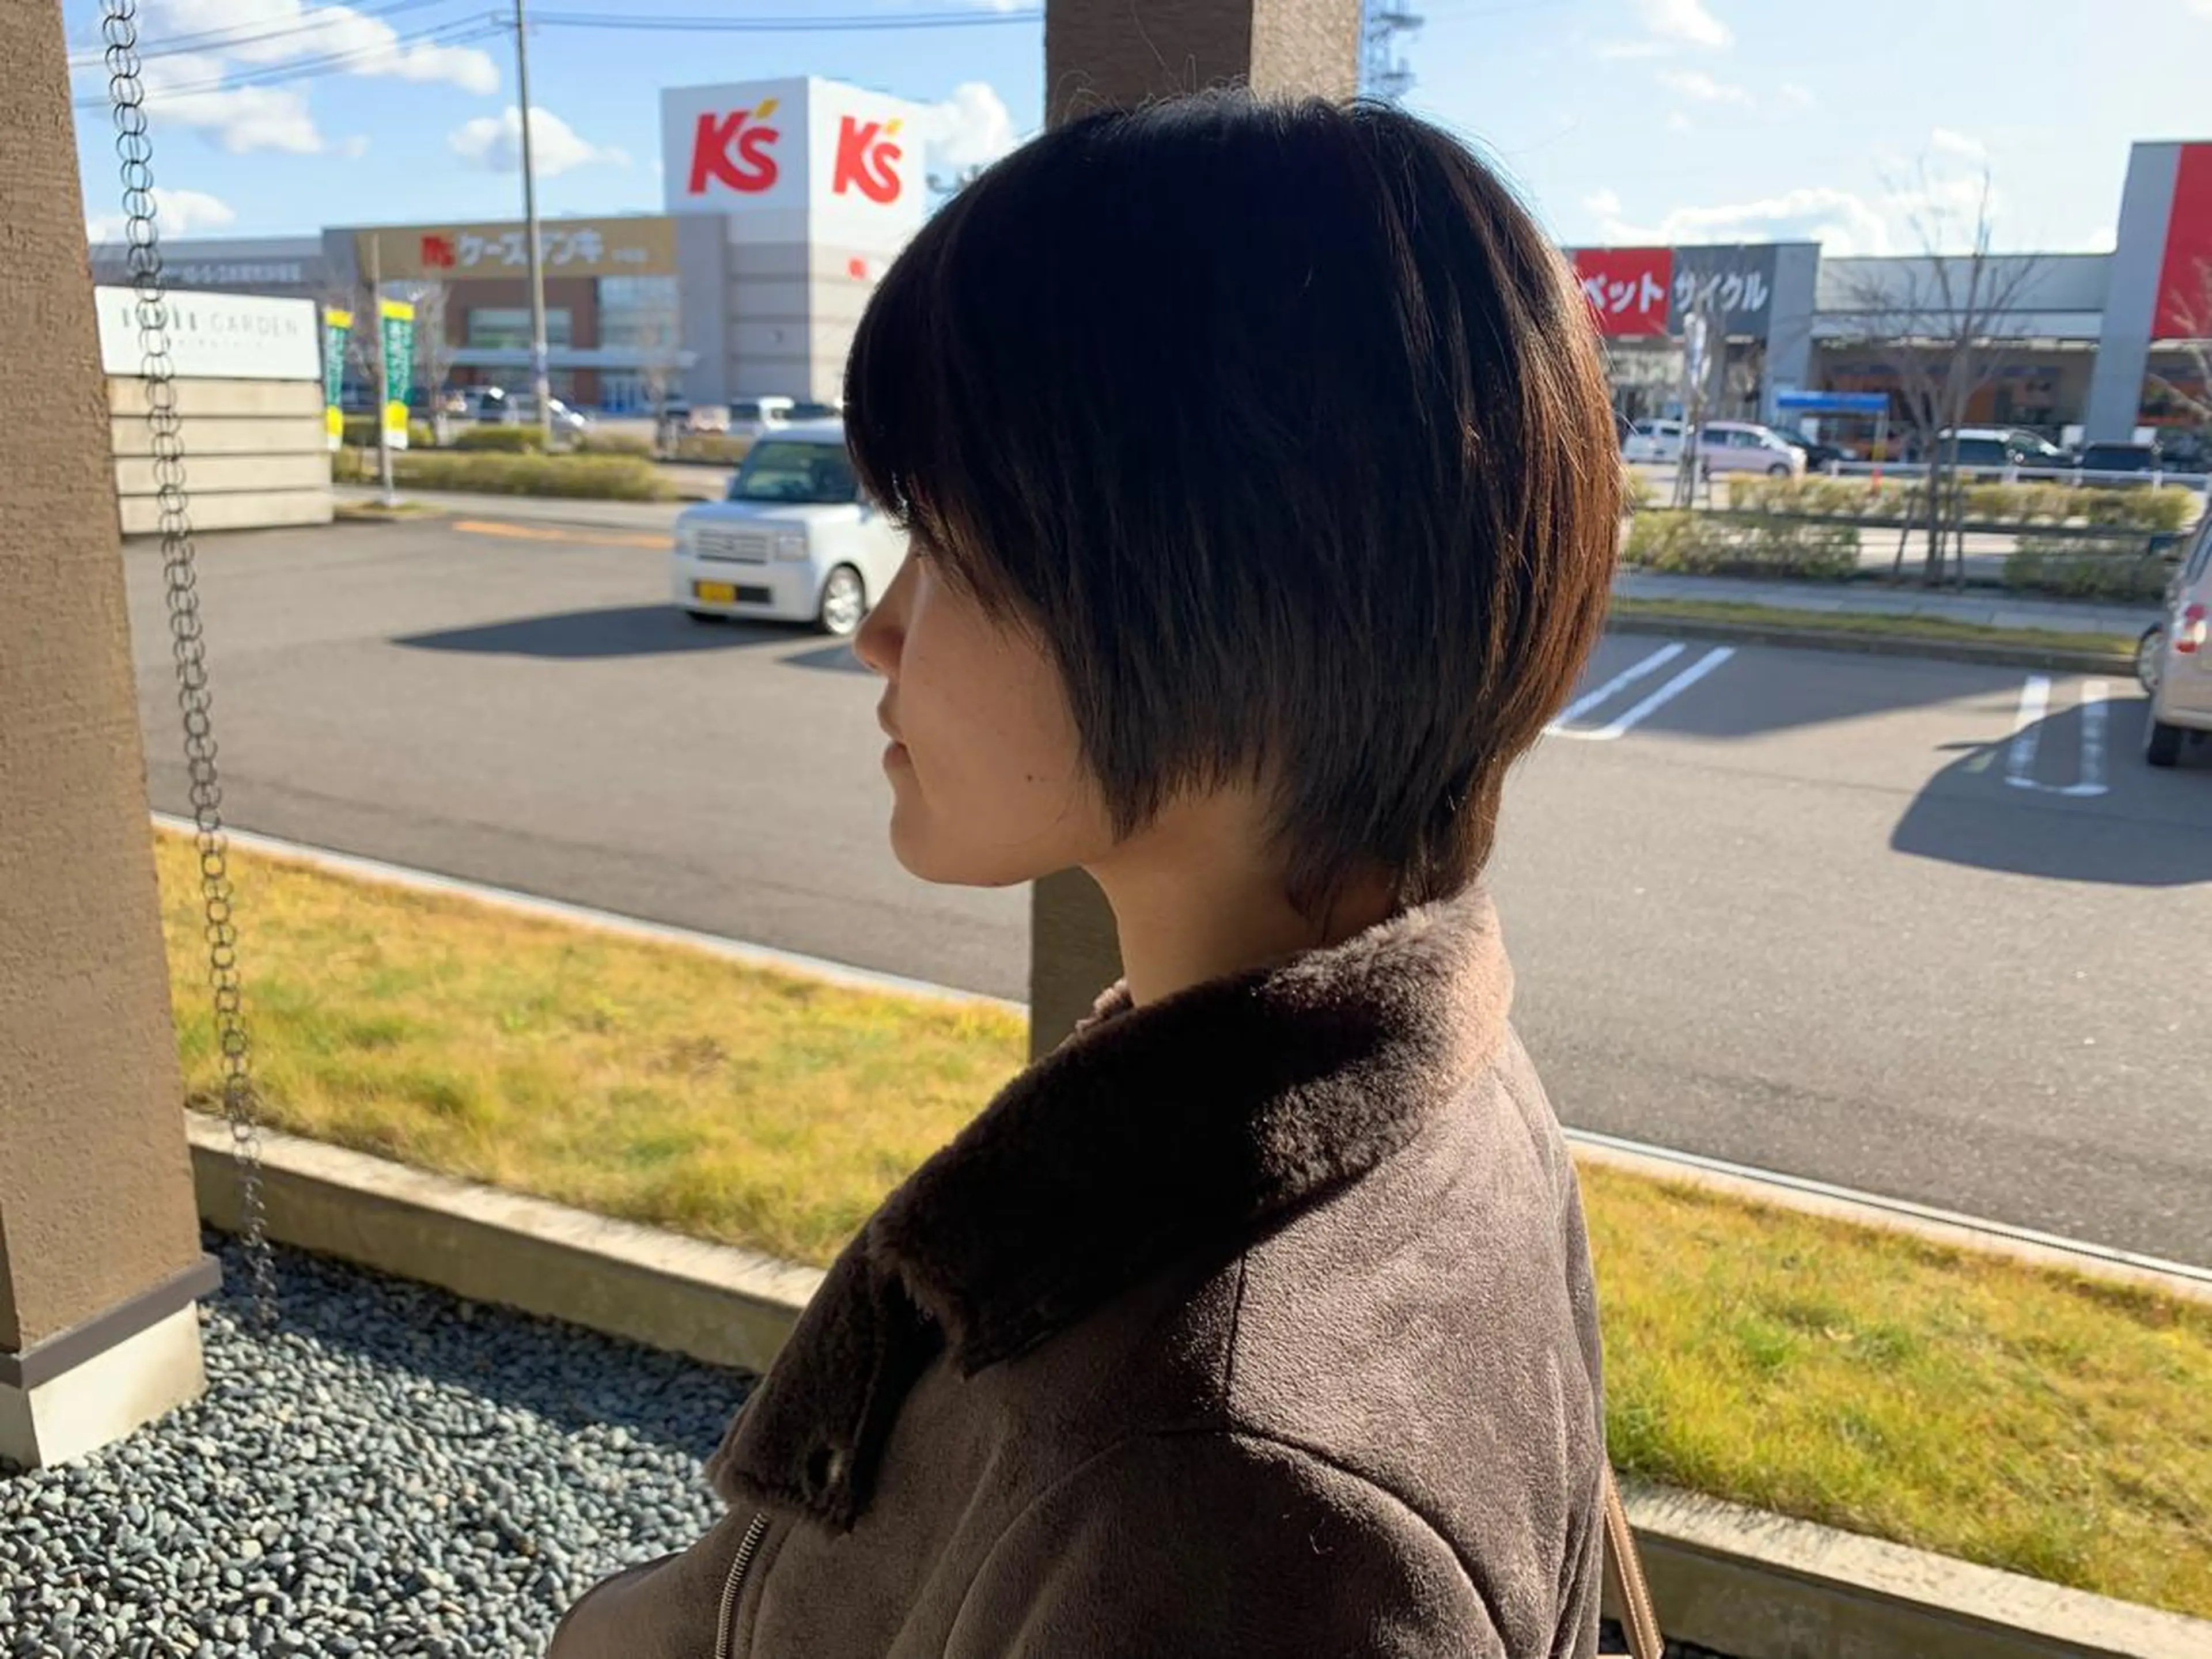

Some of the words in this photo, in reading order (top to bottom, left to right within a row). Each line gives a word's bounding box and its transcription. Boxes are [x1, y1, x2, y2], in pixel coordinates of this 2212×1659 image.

[689, 98, 779, 194] K's
[833, 115, 903, 204] K's
[210, 311, 298, 338] GARDEN
[1675, 270, 1768, 313] サイクル
